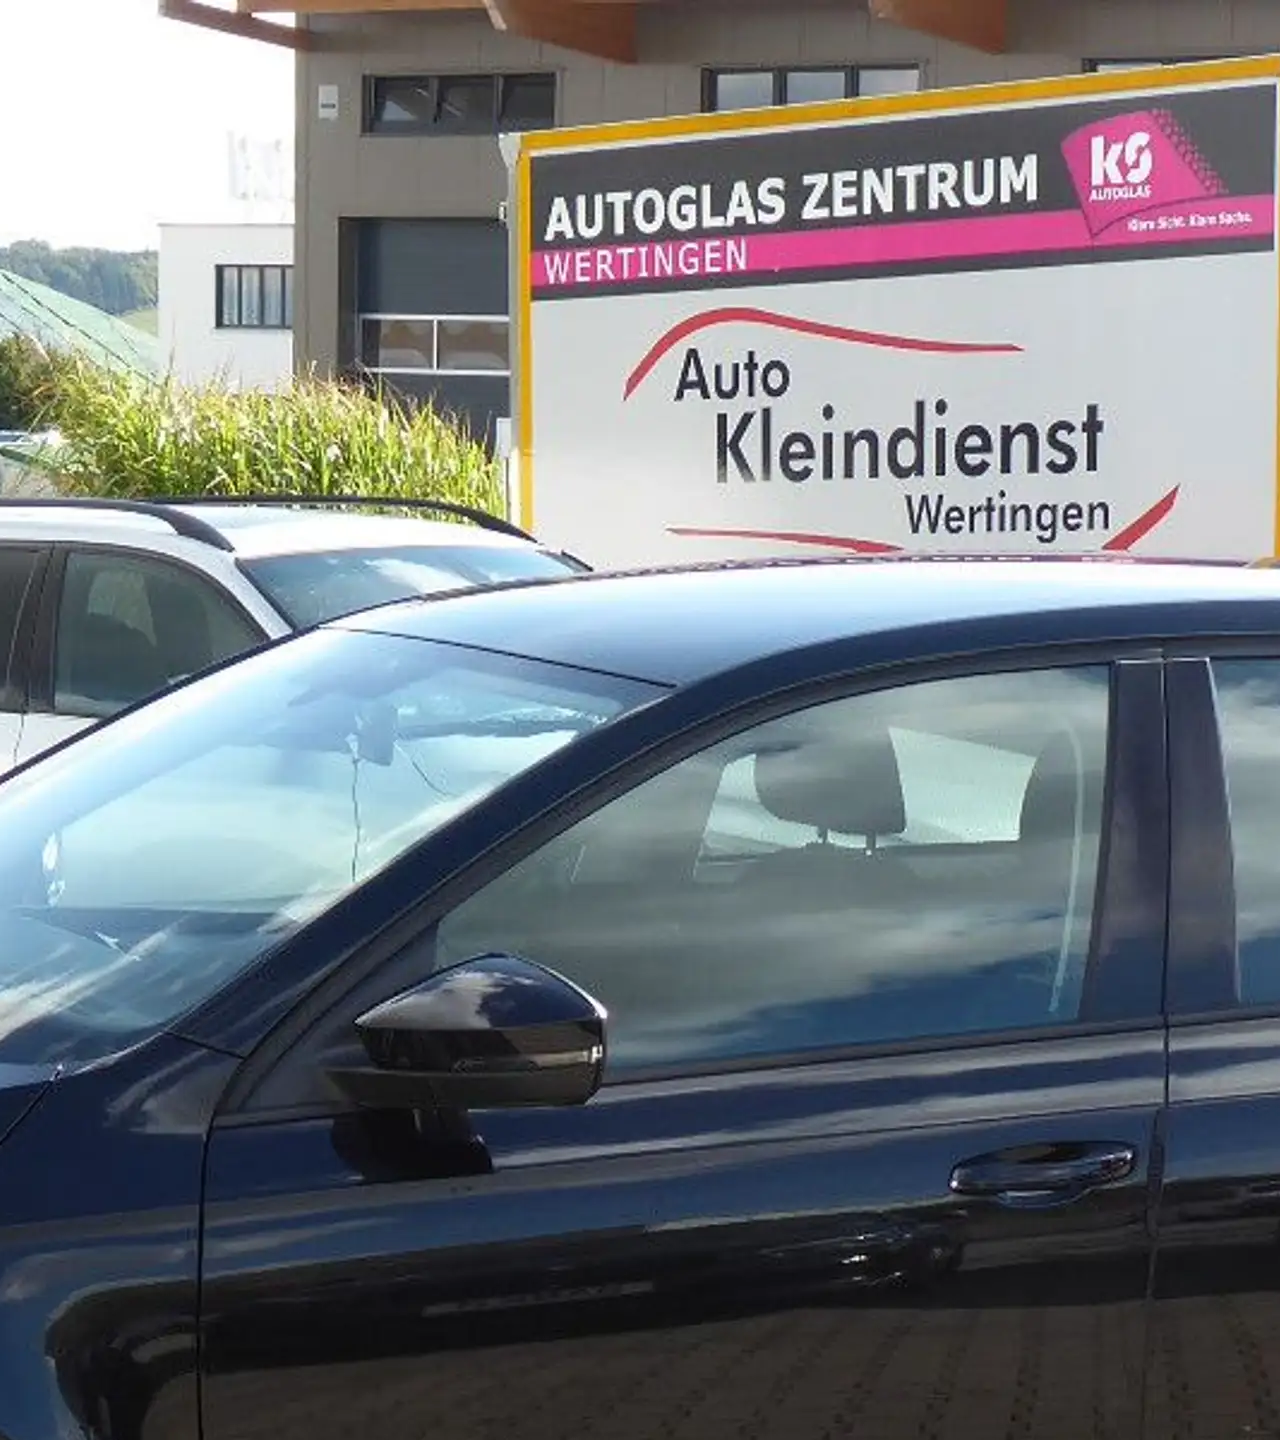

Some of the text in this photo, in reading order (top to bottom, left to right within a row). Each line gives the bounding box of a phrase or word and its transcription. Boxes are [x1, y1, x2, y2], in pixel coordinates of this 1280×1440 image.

[544, 154, 1039, 241] AUTOGLAS ZENTRUM
[1089, 185, 1153, 201] AUTOGLAS
[544, 239, 748, 285] WERTINGEN
[674, 347, 791, 401] Auto
[716, 399, 1104, 483] Kleindienst
[905, 489, 1111, 543] Wertingen
